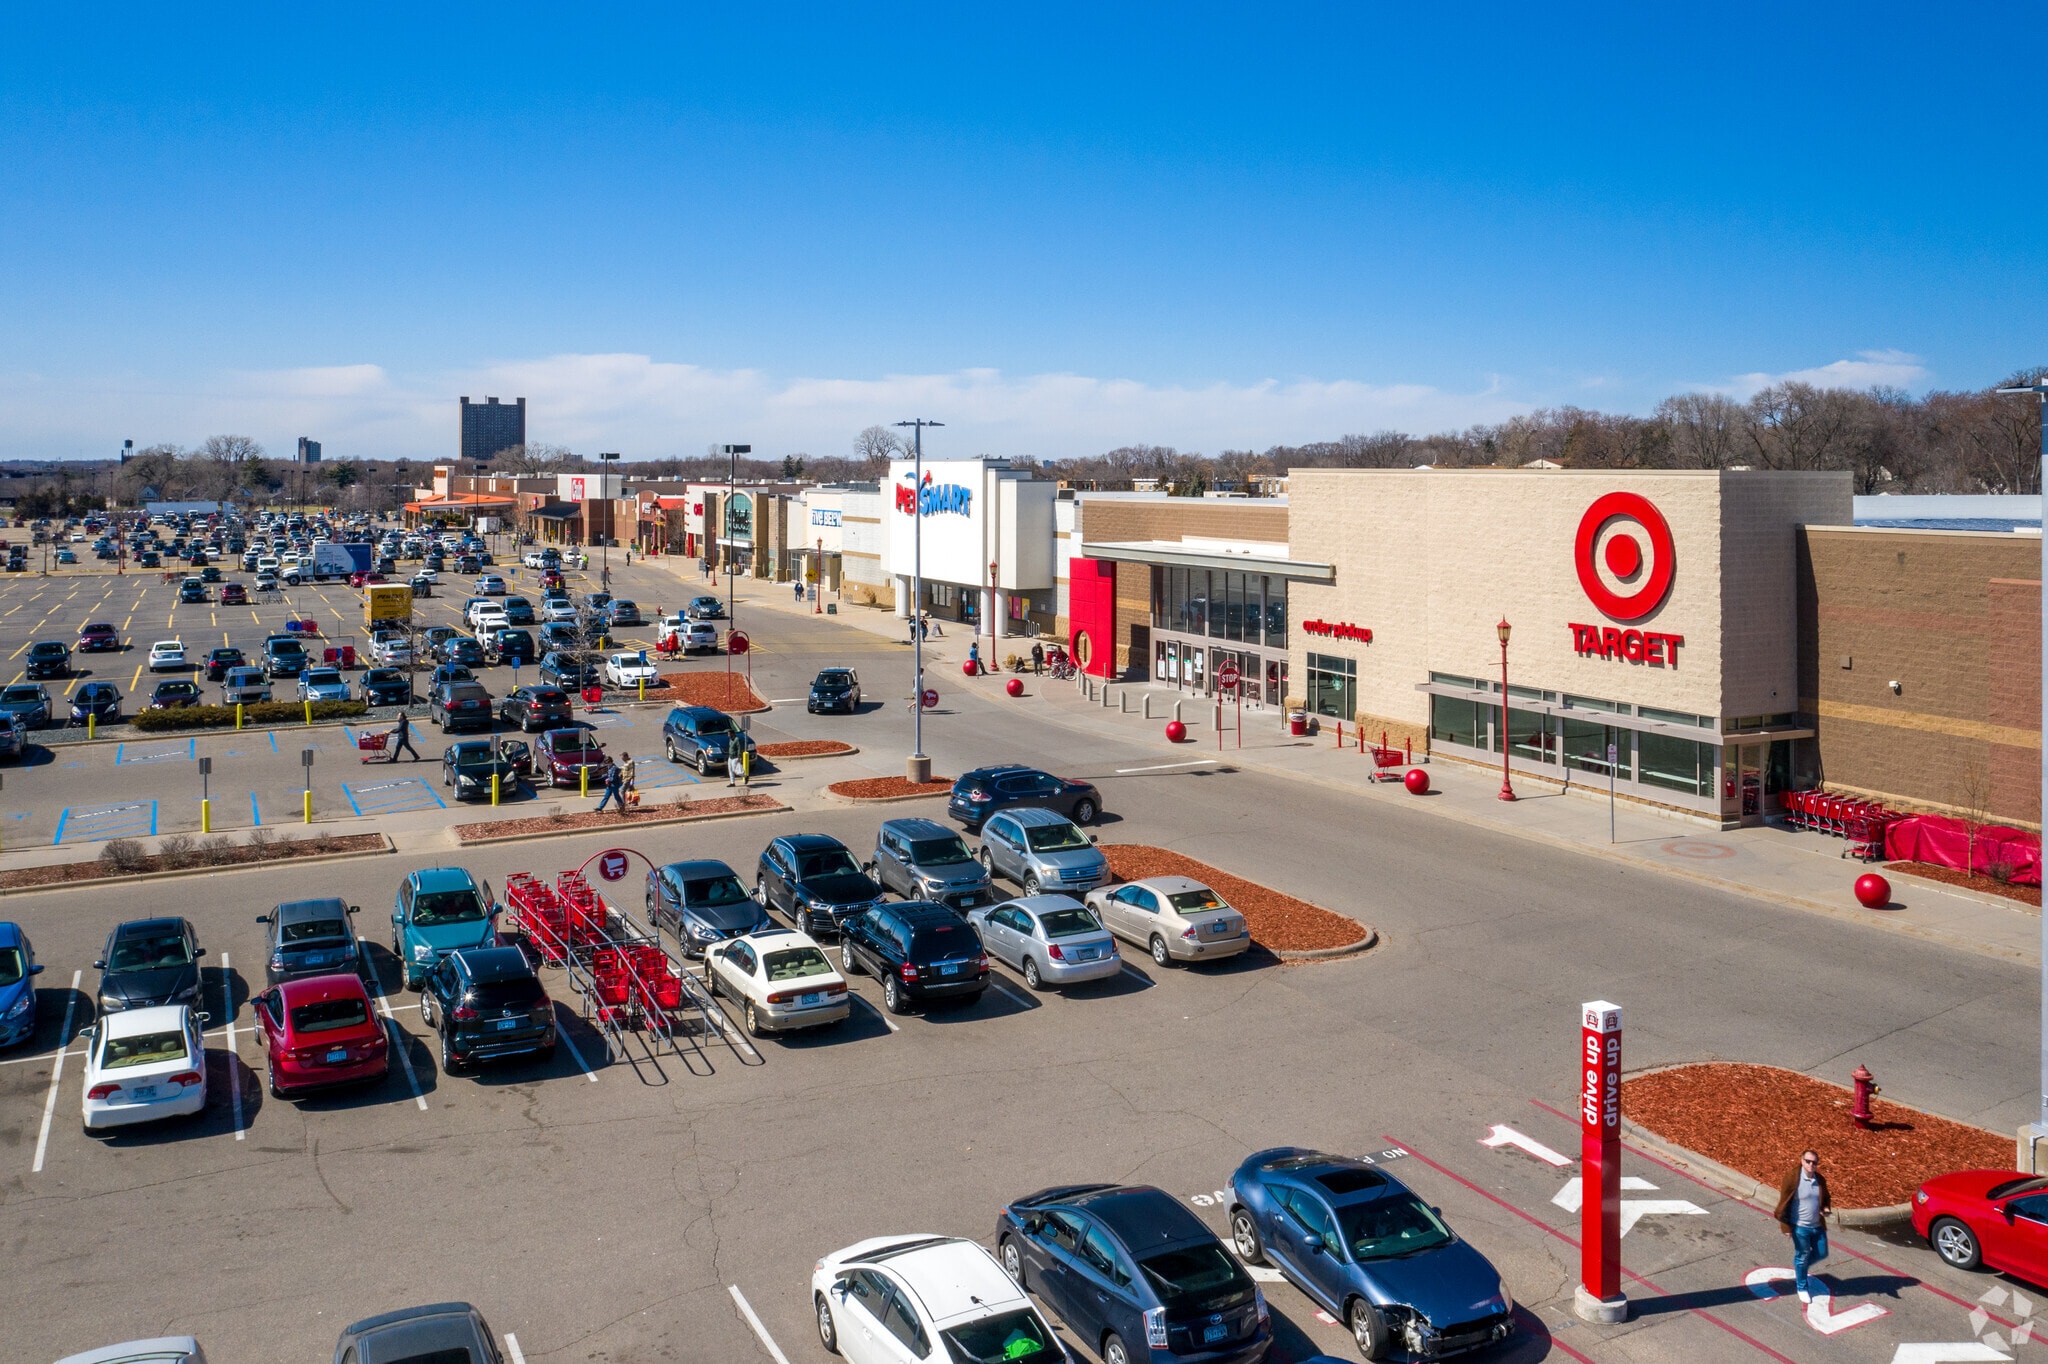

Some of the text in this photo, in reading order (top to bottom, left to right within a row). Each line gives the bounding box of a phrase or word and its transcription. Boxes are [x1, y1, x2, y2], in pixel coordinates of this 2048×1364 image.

[1303, 619, 1372, 643] order pickup
[1568, 622, 1684, 666] TARGET
[1221, 673, 1238, 683] STOP
[1583, 1035, 1601, 1126] drive up
[1603, 1037, 1620, 1127] drive up
